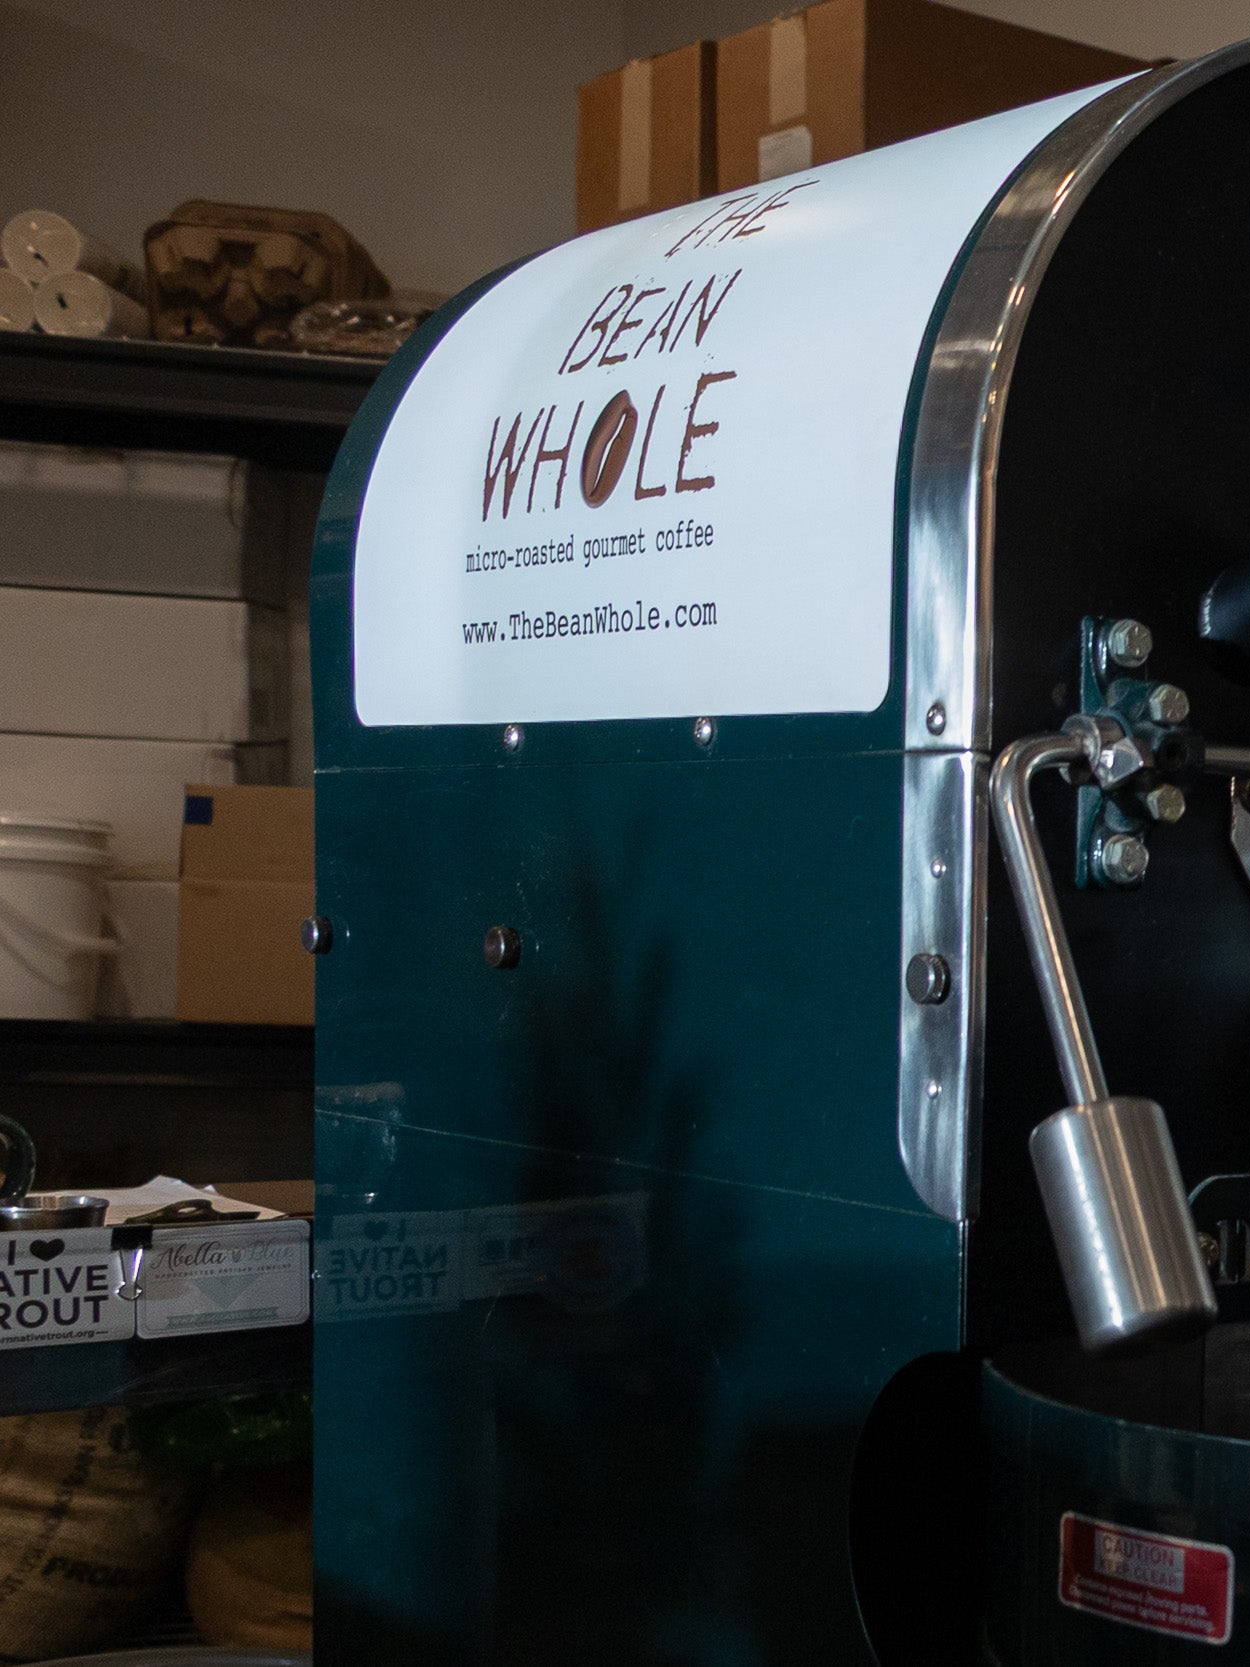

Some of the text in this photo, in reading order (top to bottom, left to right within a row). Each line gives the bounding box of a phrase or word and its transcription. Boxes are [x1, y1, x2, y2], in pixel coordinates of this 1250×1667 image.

[665, 180, 819, 258] THE
[558, 268, 742, 375] BEAN
[481, 370, 737, 522] WHOLE
[465, 519, 715, 573] micro-roasted gourmet coffee
[462, 600, 718, 644] www.TheBeanWhole.com
[150, 1241, 227, 1276] Abella
[1102, 1534, 1174, 1566] CAUTION
